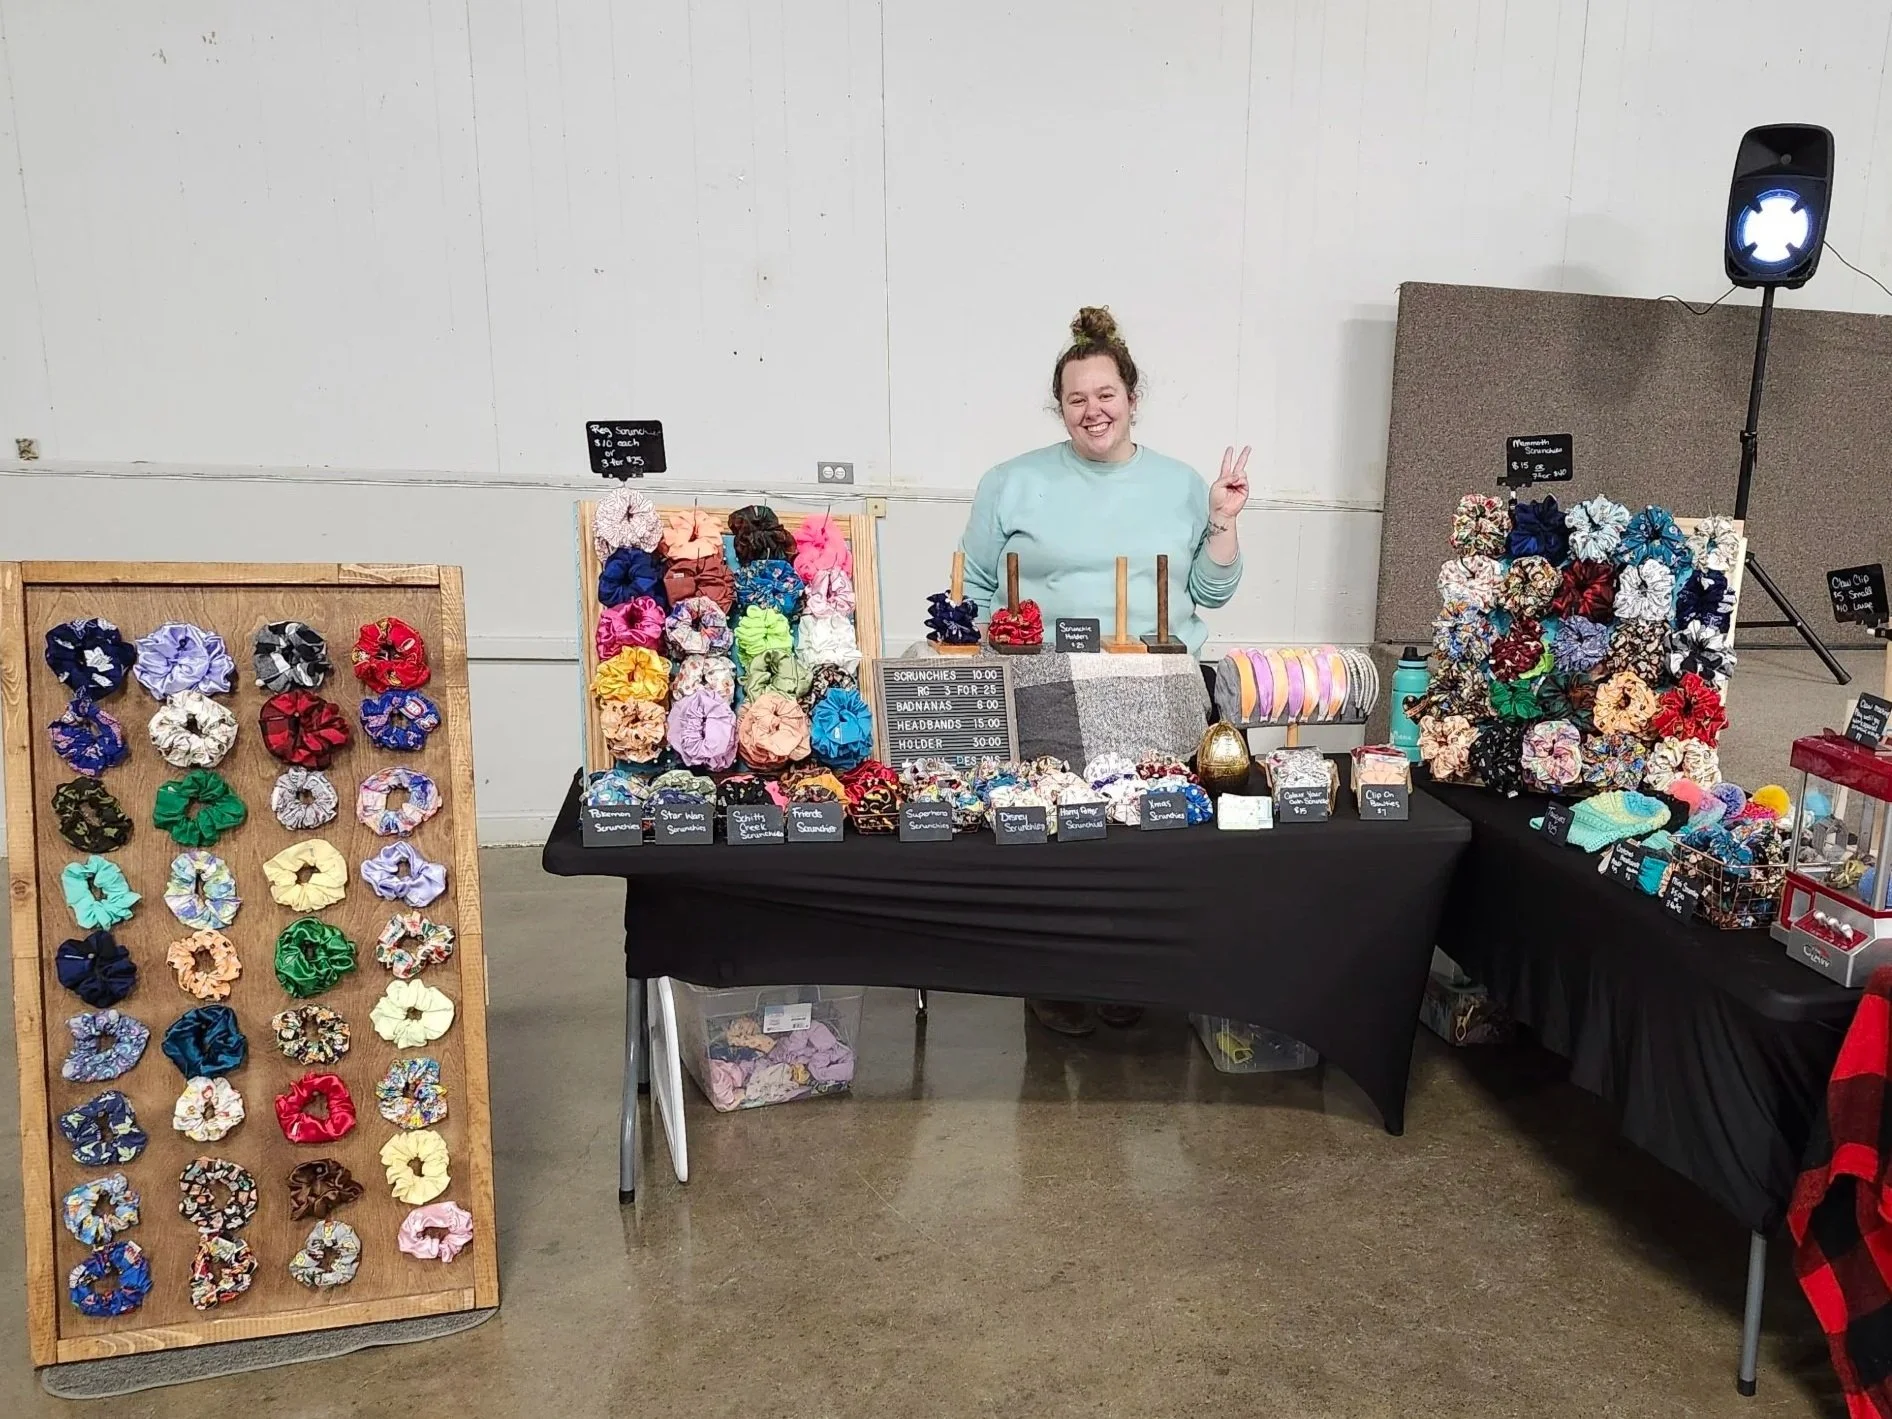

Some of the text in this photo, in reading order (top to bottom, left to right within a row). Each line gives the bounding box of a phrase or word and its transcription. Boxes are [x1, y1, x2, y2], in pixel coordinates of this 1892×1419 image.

[590, 424, 612, 438] Reg
[594, 438, 640, 447] $10 each
[1512, 439, 1550, 448] Mammoth
[604, 449, 616, 457] or
[601, 456, 645, 468] 3 for $25
[1853, 574, 1869, 586] Clip
[1848, 586, 1872, 599] Small
[1059, 621, 1092, 632] Scrunchie
[893, 670, 957, 681] SCRUNCHIES
[944, 686, 951, 696] 3
[957, 685, 978, 695] FOR
[983, 685, 997, 695] 25
[896, 700, 953, 712] BADNANAS
[897, 719, 962, 731] HEADBANDS
[898, 738, 943, 749] HOLDER
[1366, 789, 1382, 800] Clip
[1148, 799, 1172, 810] Xmas
[588, 808, 631, 818] Pokemon
[661, 809, 705, 821] Star Wars
[792, 806, 823, 819] Friends
[1060, 808, 1080, 820] Harry
[1294, 806, 1308, 815] $15
[999, 812, 1029, 825] Disney
[594, 823, 640, 832] Scrunchies
[740, 823, 767, 831] Creek
